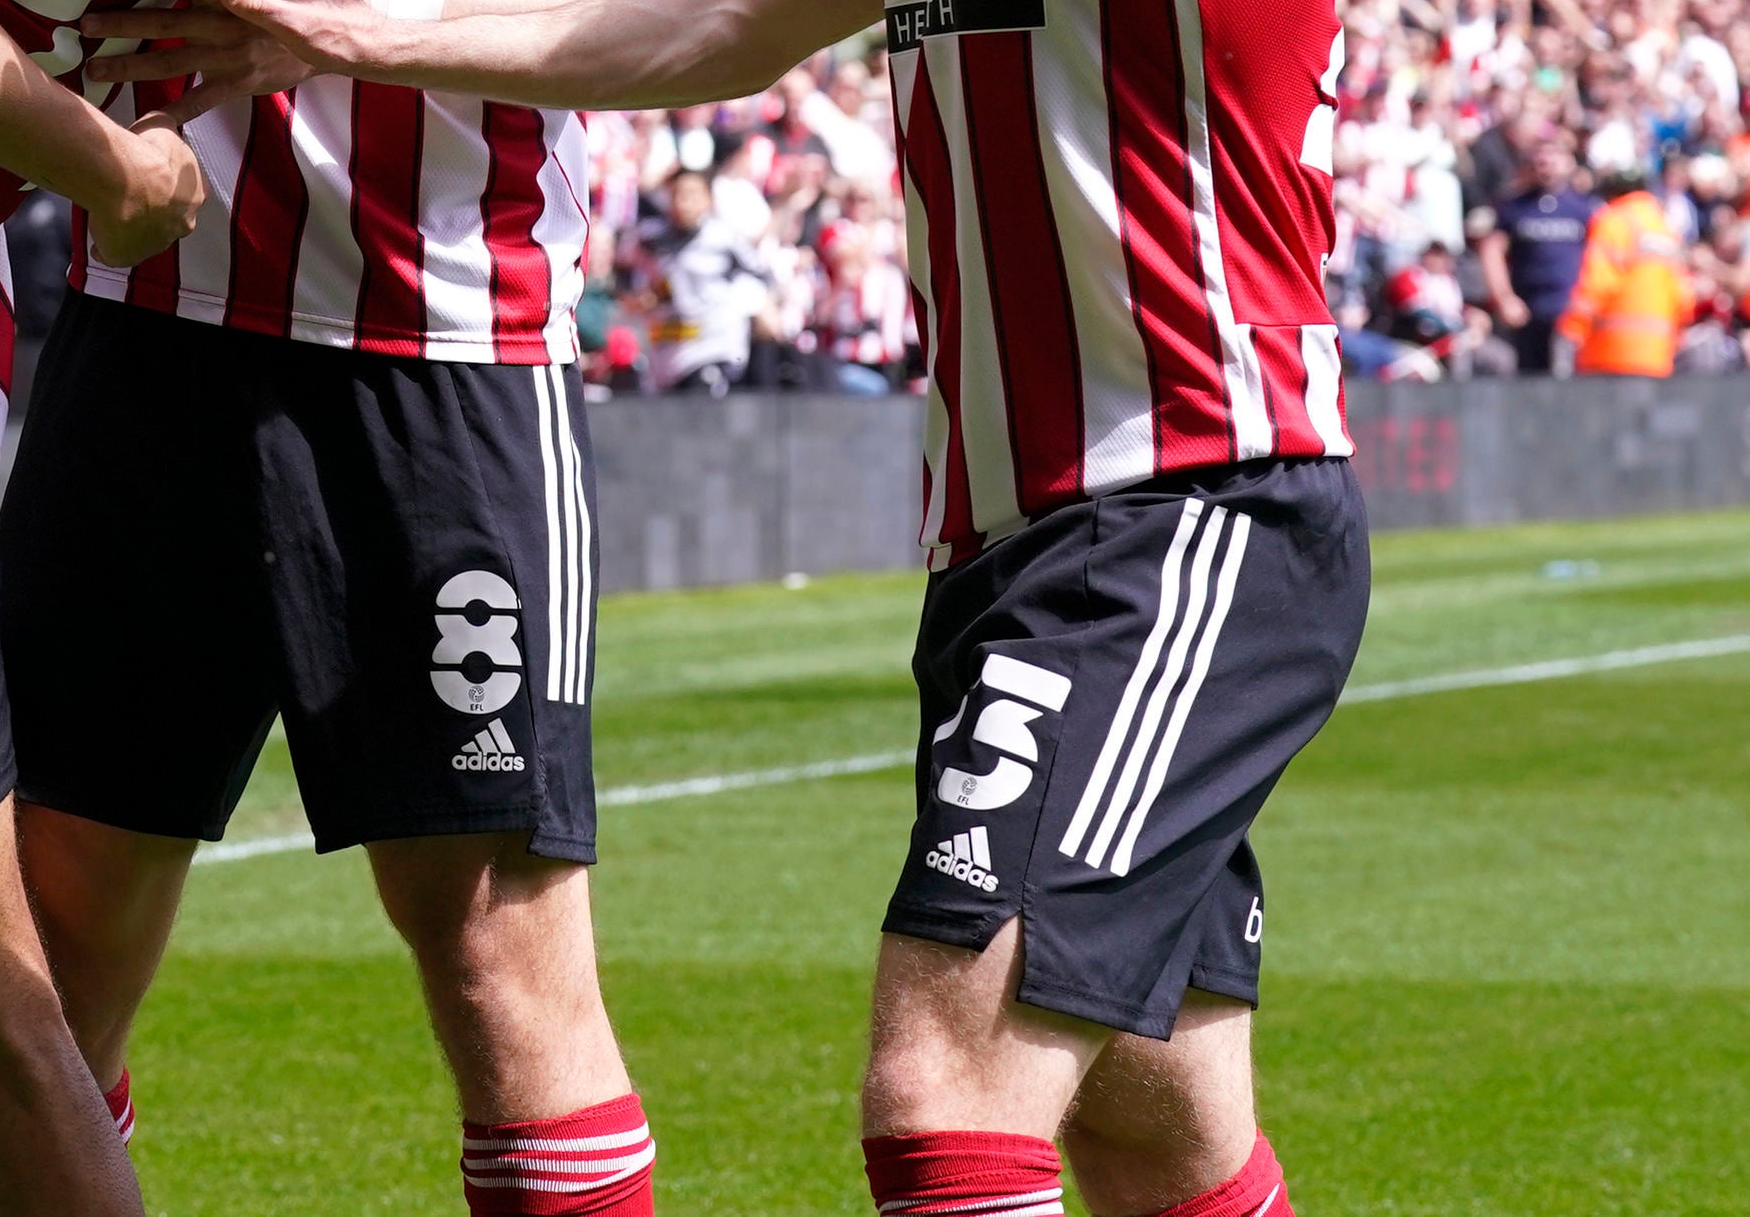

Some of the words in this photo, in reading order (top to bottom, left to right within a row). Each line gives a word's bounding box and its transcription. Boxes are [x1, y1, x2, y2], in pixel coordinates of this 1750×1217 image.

[429, 569, 523, 715] 8
[469, 703, 484, 712] EFL
[451, 750, 526, 772] adidas
[956, 795, 970, 806] EFL
[925, 850, 1000, 893] adidas
